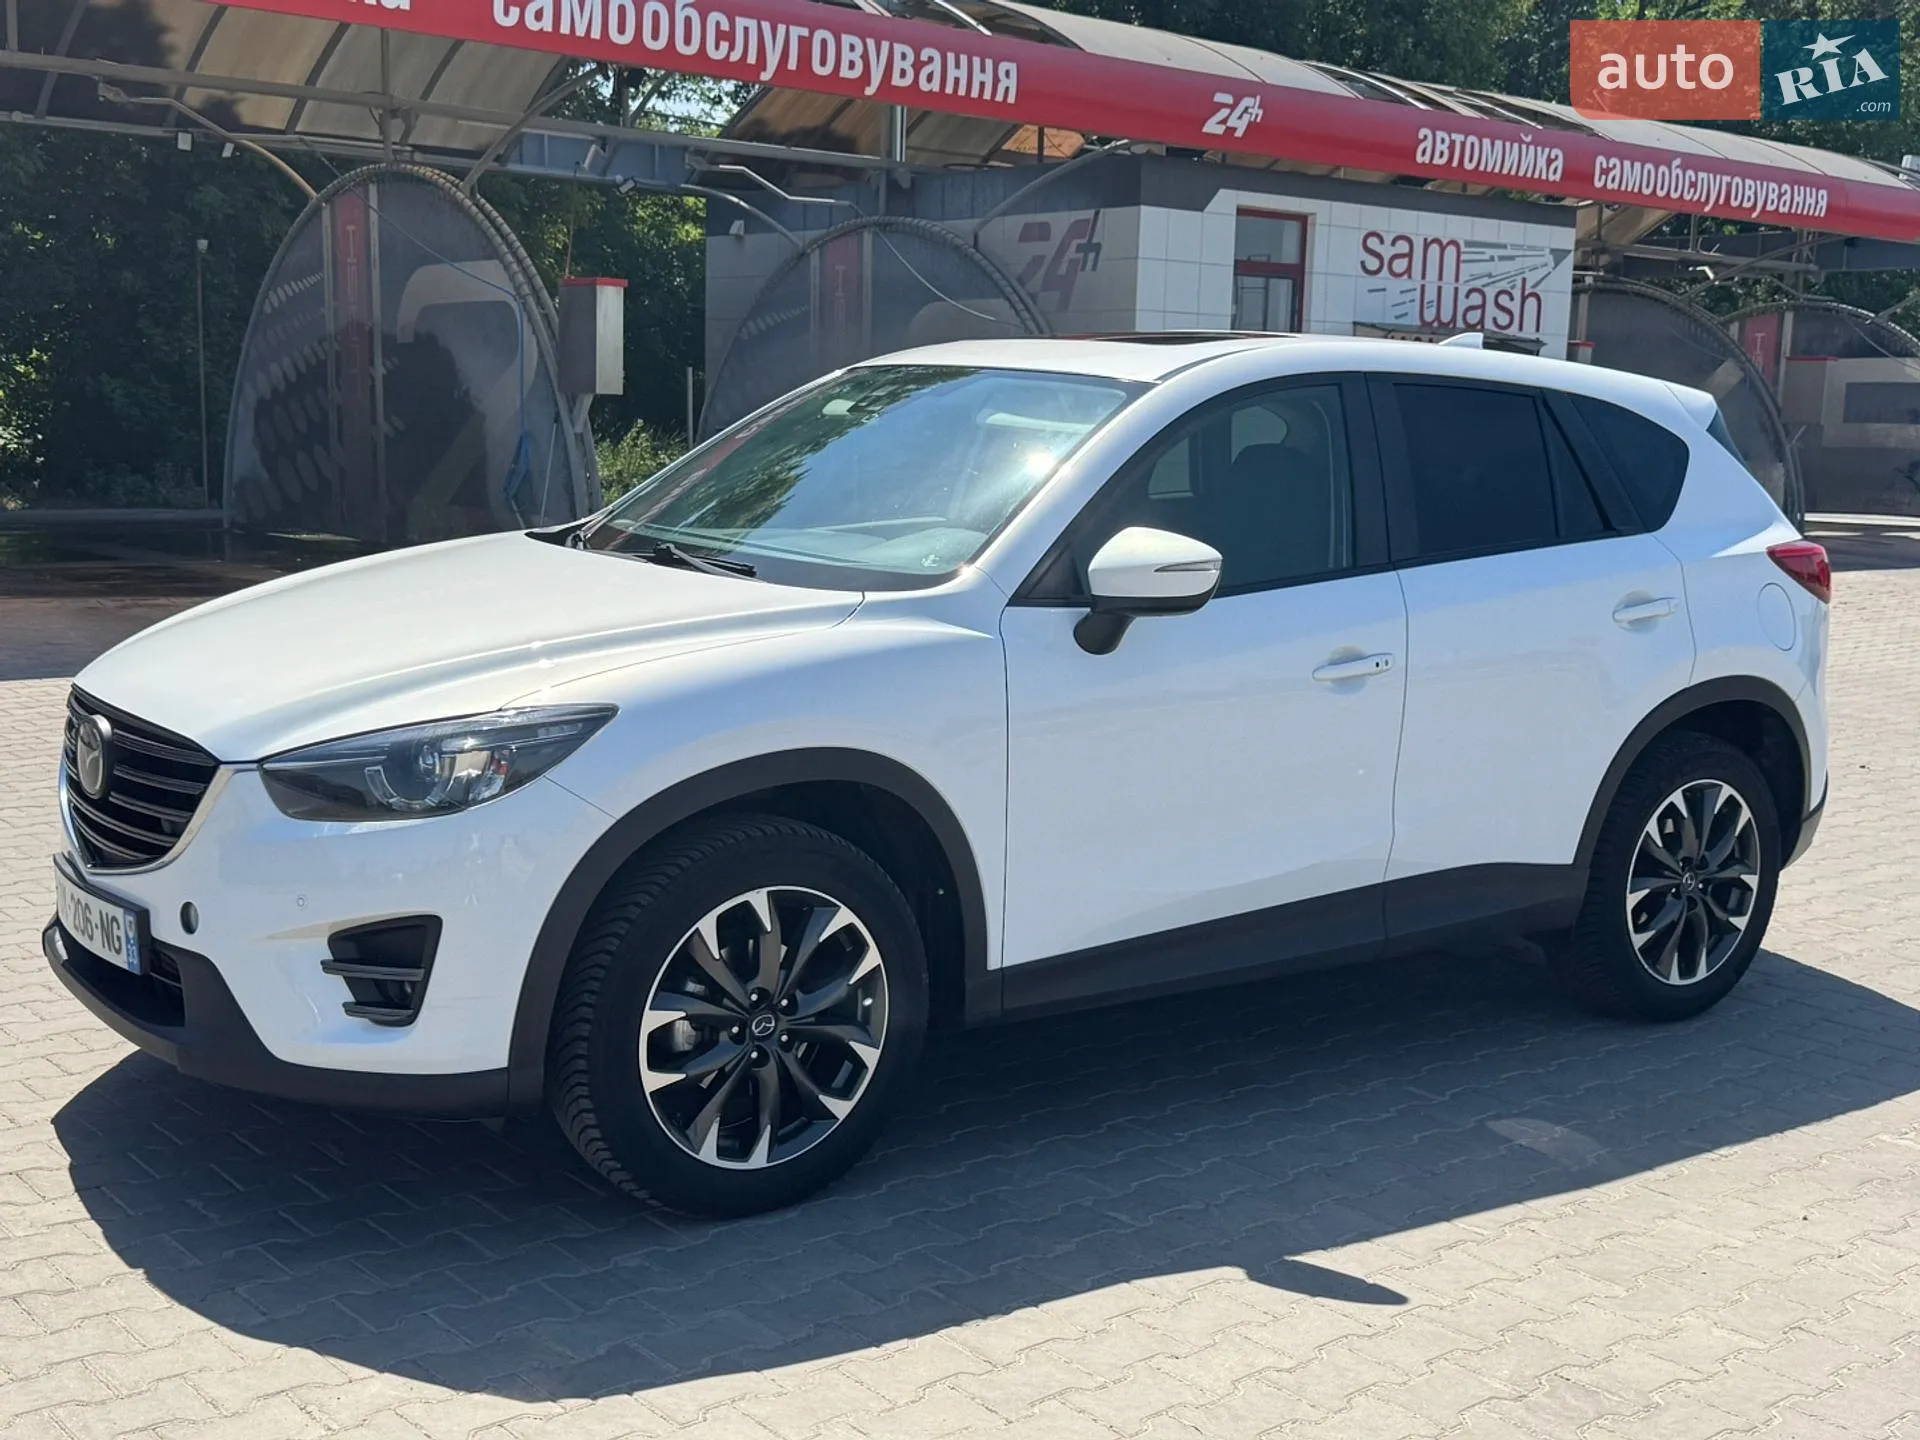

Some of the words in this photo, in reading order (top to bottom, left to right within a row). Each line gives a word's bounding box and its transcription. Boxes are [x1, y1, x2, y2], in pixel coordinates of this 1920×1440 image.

[1415, 127, 1564, 182] автомийка
[1593, 154, 1829, 218] самообслуговування
[1360, 230, 1462, 283] sam
[1419, 277, 1543, 333] wash
